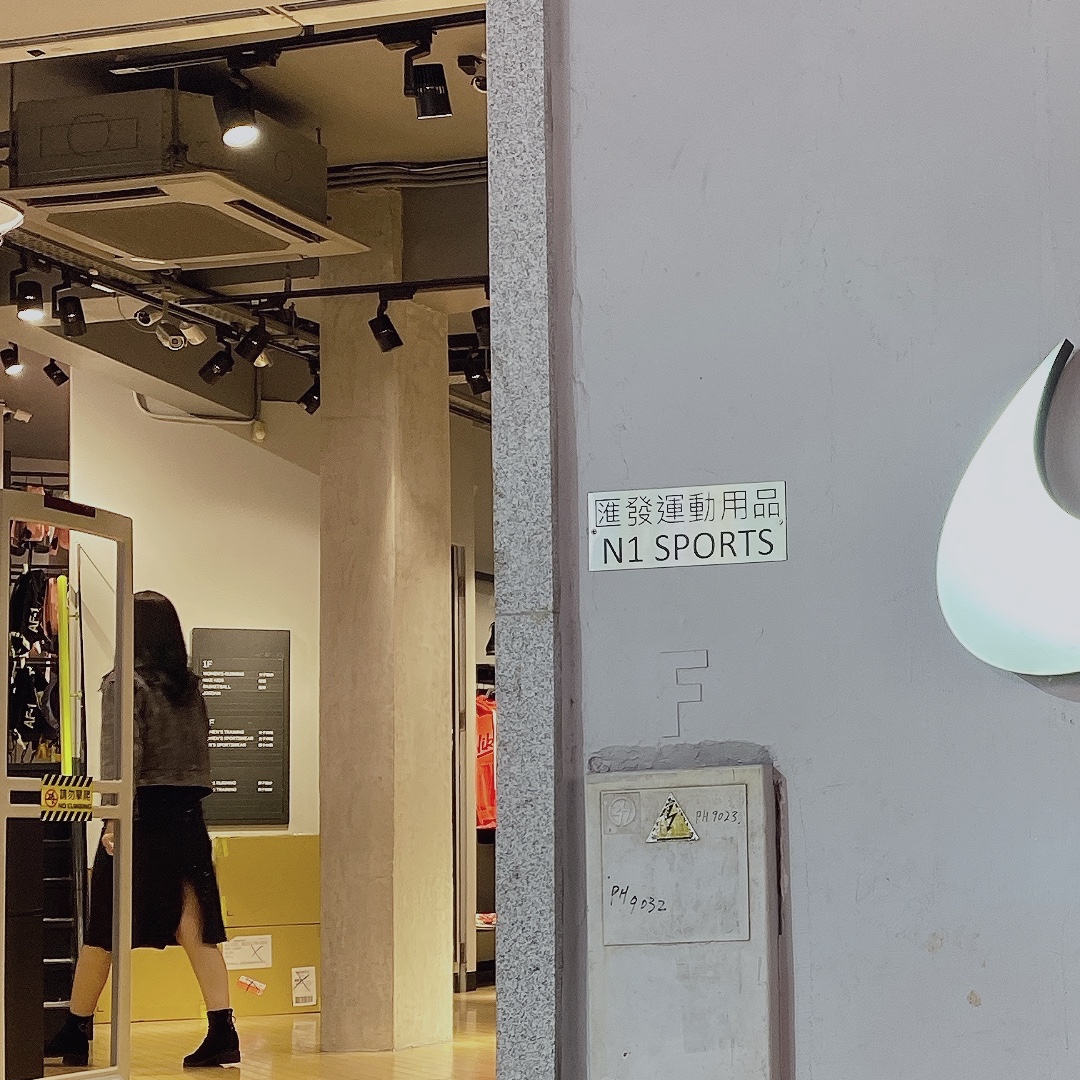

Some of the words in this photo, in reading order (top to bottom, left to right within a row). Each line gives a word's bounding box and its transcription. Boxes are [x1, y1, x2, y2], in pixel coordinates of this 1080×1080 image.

[595, 488, 780, 527] 匯發運動用品
[603, 536, 643, 564] N1
[654, 528, 774, 562] SPORTS
